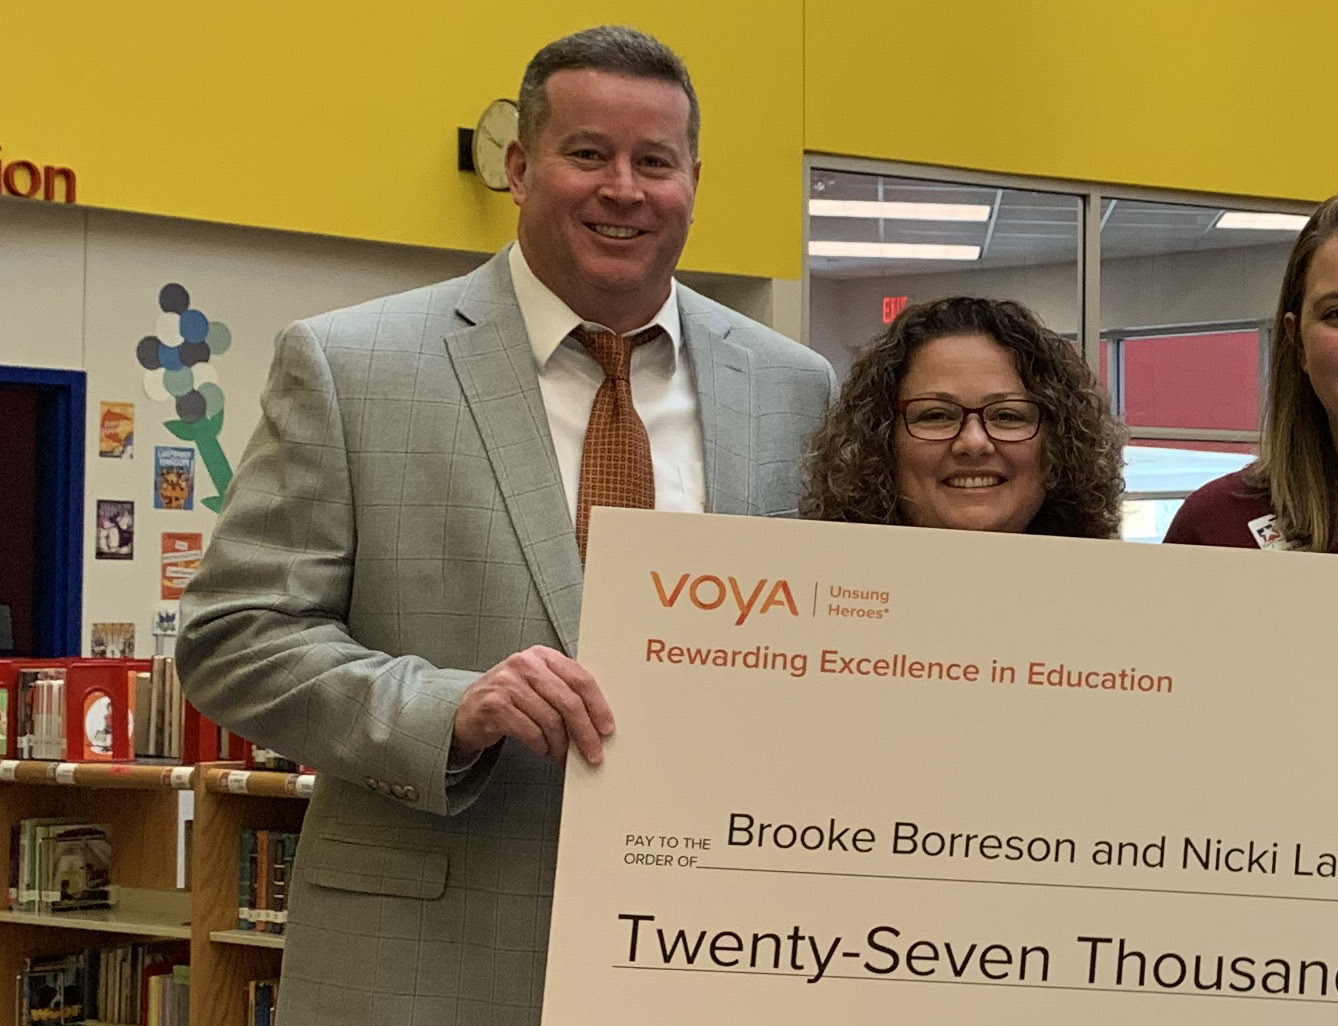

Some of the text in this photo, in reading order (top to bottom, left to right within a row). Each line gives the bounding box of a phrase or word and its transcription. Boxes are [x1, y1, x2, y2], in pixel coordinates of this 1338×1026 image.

[0, 144, 76, 203] on
[650, 571, 800, 626] VOYA
[829, 585, 890, 603] Unsung
[646, 638, 1174, 694] Rewarding Excellence in Education
[624, 853, 698, 868] ORDER OF
[625, 834, 711, 850] PAY TO THE
[726, 812, 876, 853] Brooke
[892, 821, 1076, 864] Borreson
[1091, 836, 1166, 868] and
[1182, 837, 1279, 874] Nicki
[618, 913, 1051, 984] Twenty-Seven
